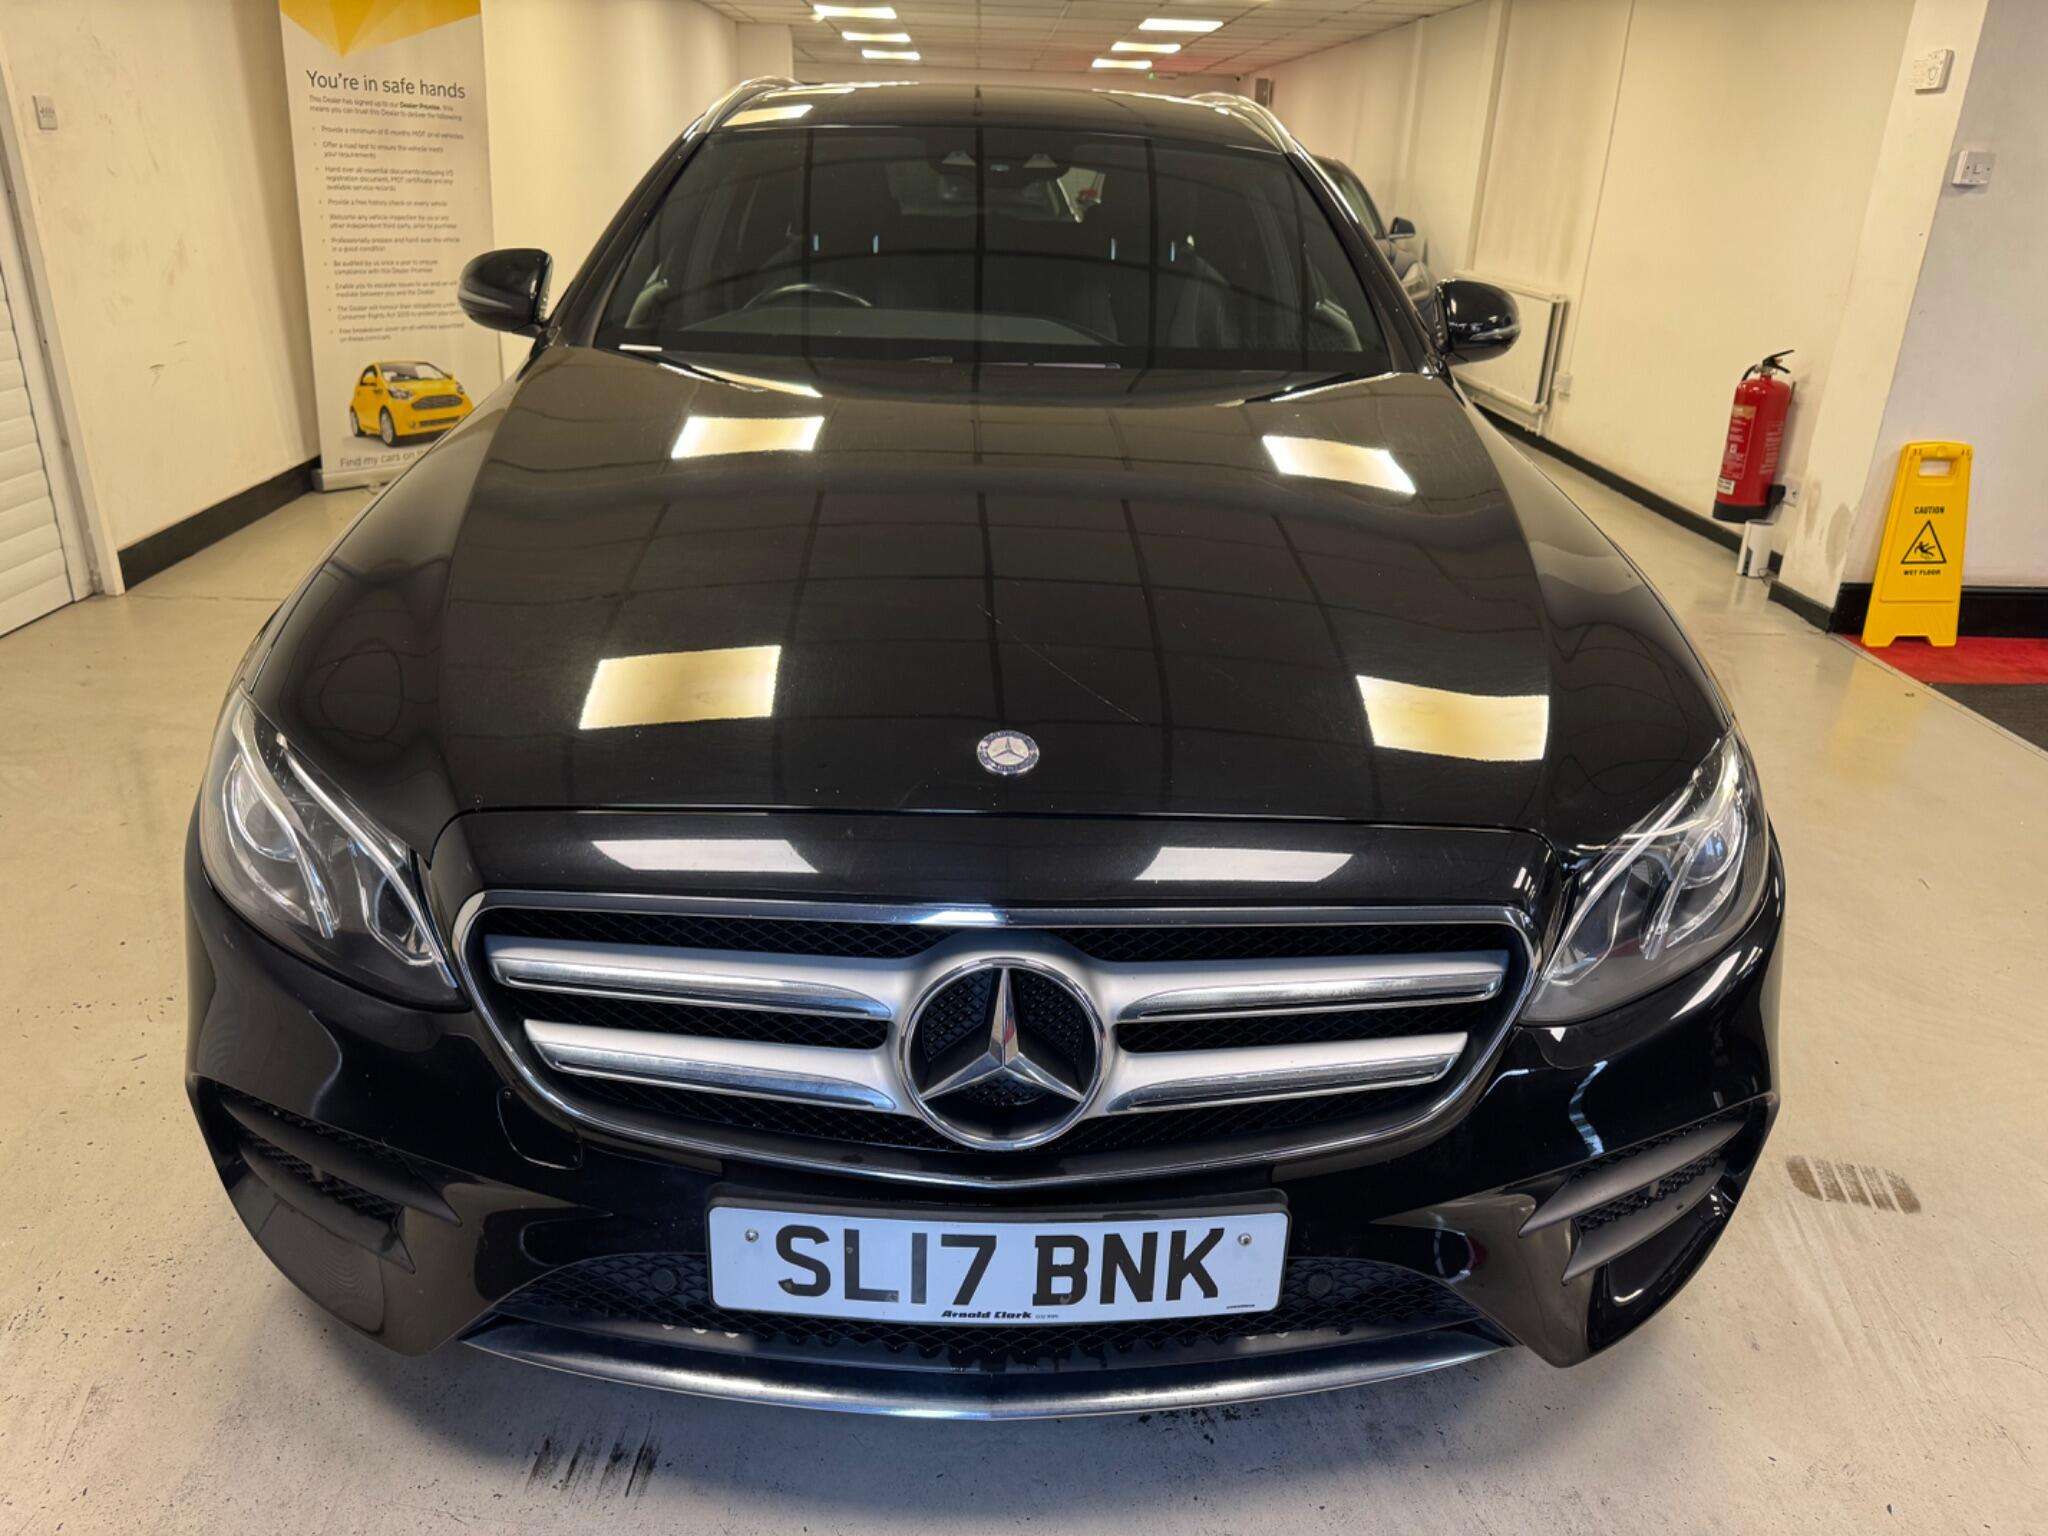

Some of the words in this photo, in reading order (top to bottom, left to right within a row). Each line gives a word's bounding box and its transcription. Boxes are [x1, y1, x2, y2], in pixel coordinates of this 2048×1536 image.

[306, 70, 360, 90] You're
[363, 75, 379, 92] in
[382, 77, 415, 95] safe
[420, 79, 466, 99] hands
[340, 456, 361, 467] Find
[363, 456, 378, 466] my
[402, 451, 415, 460] on
[1914, 506, 1945, 515] CAUTION
[775, 1223, 998, 1306] SL17
[1031, 1227, 1226, 1307] BNK
[941, 1309, 991, 1319] Arnold
[993, 1311, 1032, 1319] Clark
